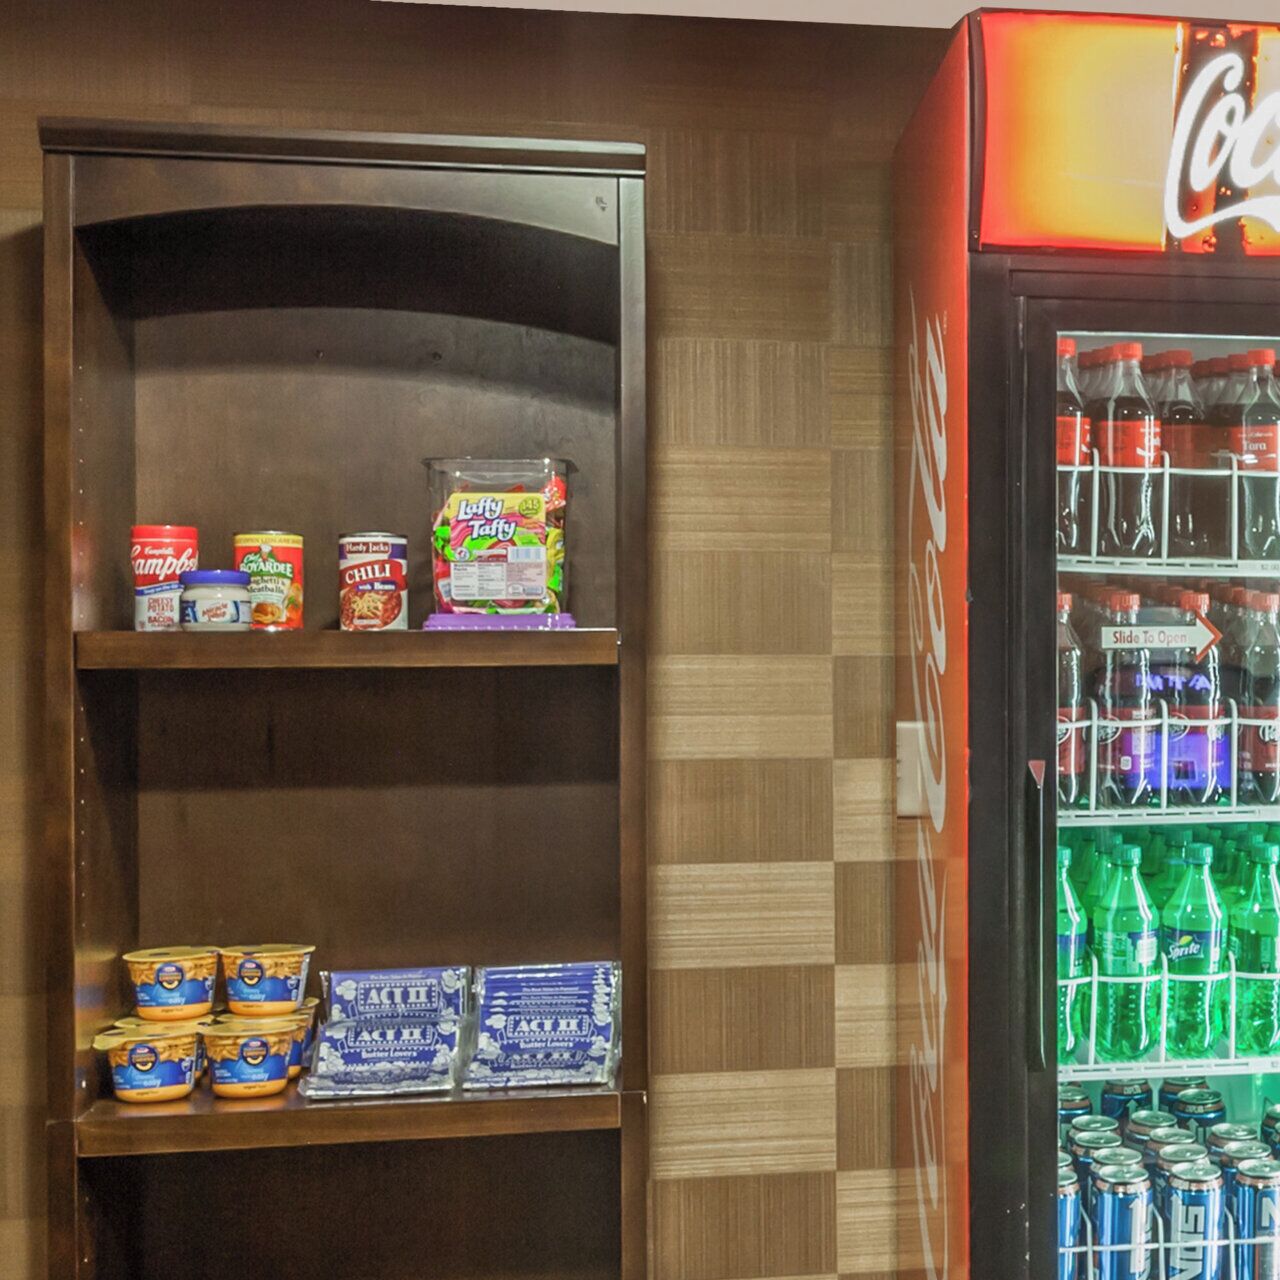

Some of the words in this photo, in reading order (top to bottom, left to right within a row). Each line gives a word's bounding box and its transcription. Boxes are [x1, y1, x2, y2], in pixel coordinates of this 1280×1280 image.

[457, 497, 503, 520] Laffy
[469, 519, 517, 542] Taffy
[369, 543, 389, 553] Jacks
[345, 564, 391, 584] CHILI
[1112, 630, 1139, 644] Slide
[1142, 631, 1154, 643] To
[1157, 630, 1187, 646] Open
[1168, 941, 1201, 961] Sprite
[367, 987, 404, 1005] ACT
[407, 986, 430, 1003] II
[356, 1025, 395, 1041] ACT
[399, 1024, 423, 1041] II
[516, 1015, 558, 1033] ACT
[559, 1015, 585, 1033] II
